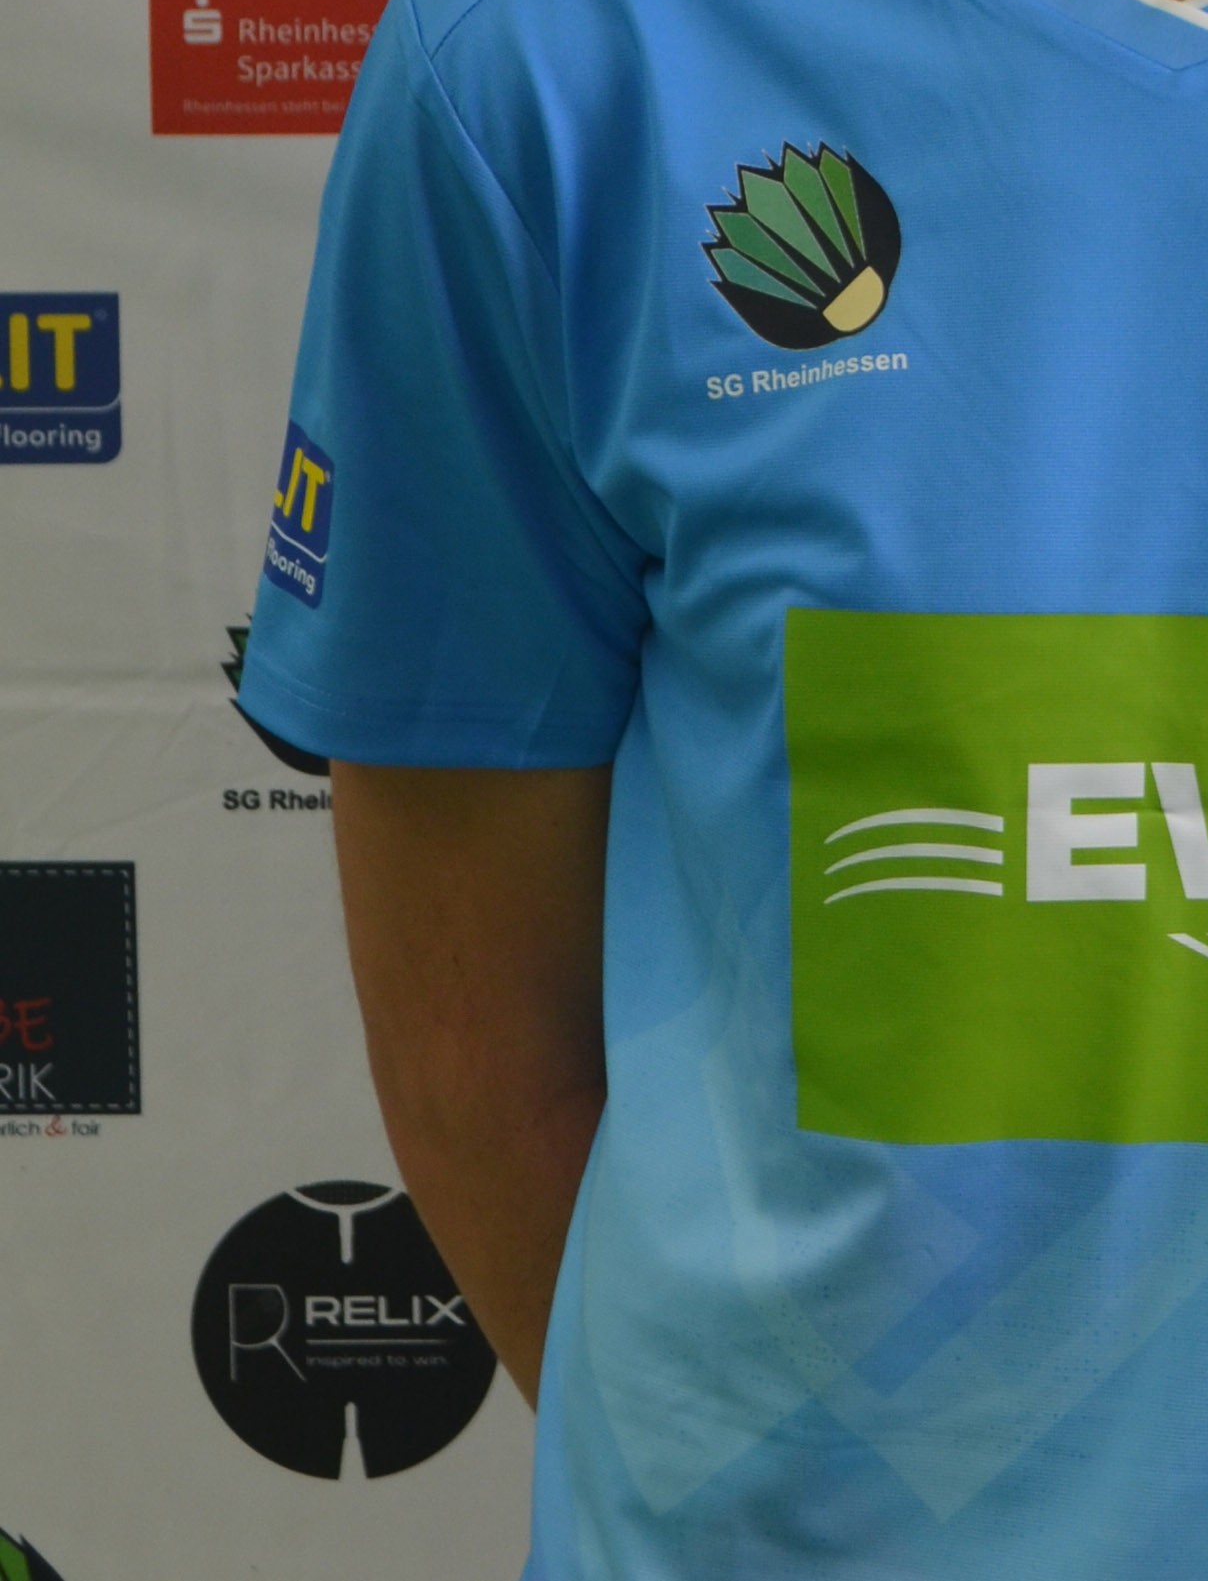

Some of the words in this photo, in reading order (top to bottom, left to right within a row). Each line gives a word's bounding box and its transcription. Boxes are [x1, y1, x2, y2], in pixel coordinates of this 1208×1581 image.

[706, 372, 744, 399] SG
[751, 352, 908, 393] Rheinhessen
[223, 789, 261, 811] SG
[305, 1295, 466, 1326] RELIX
